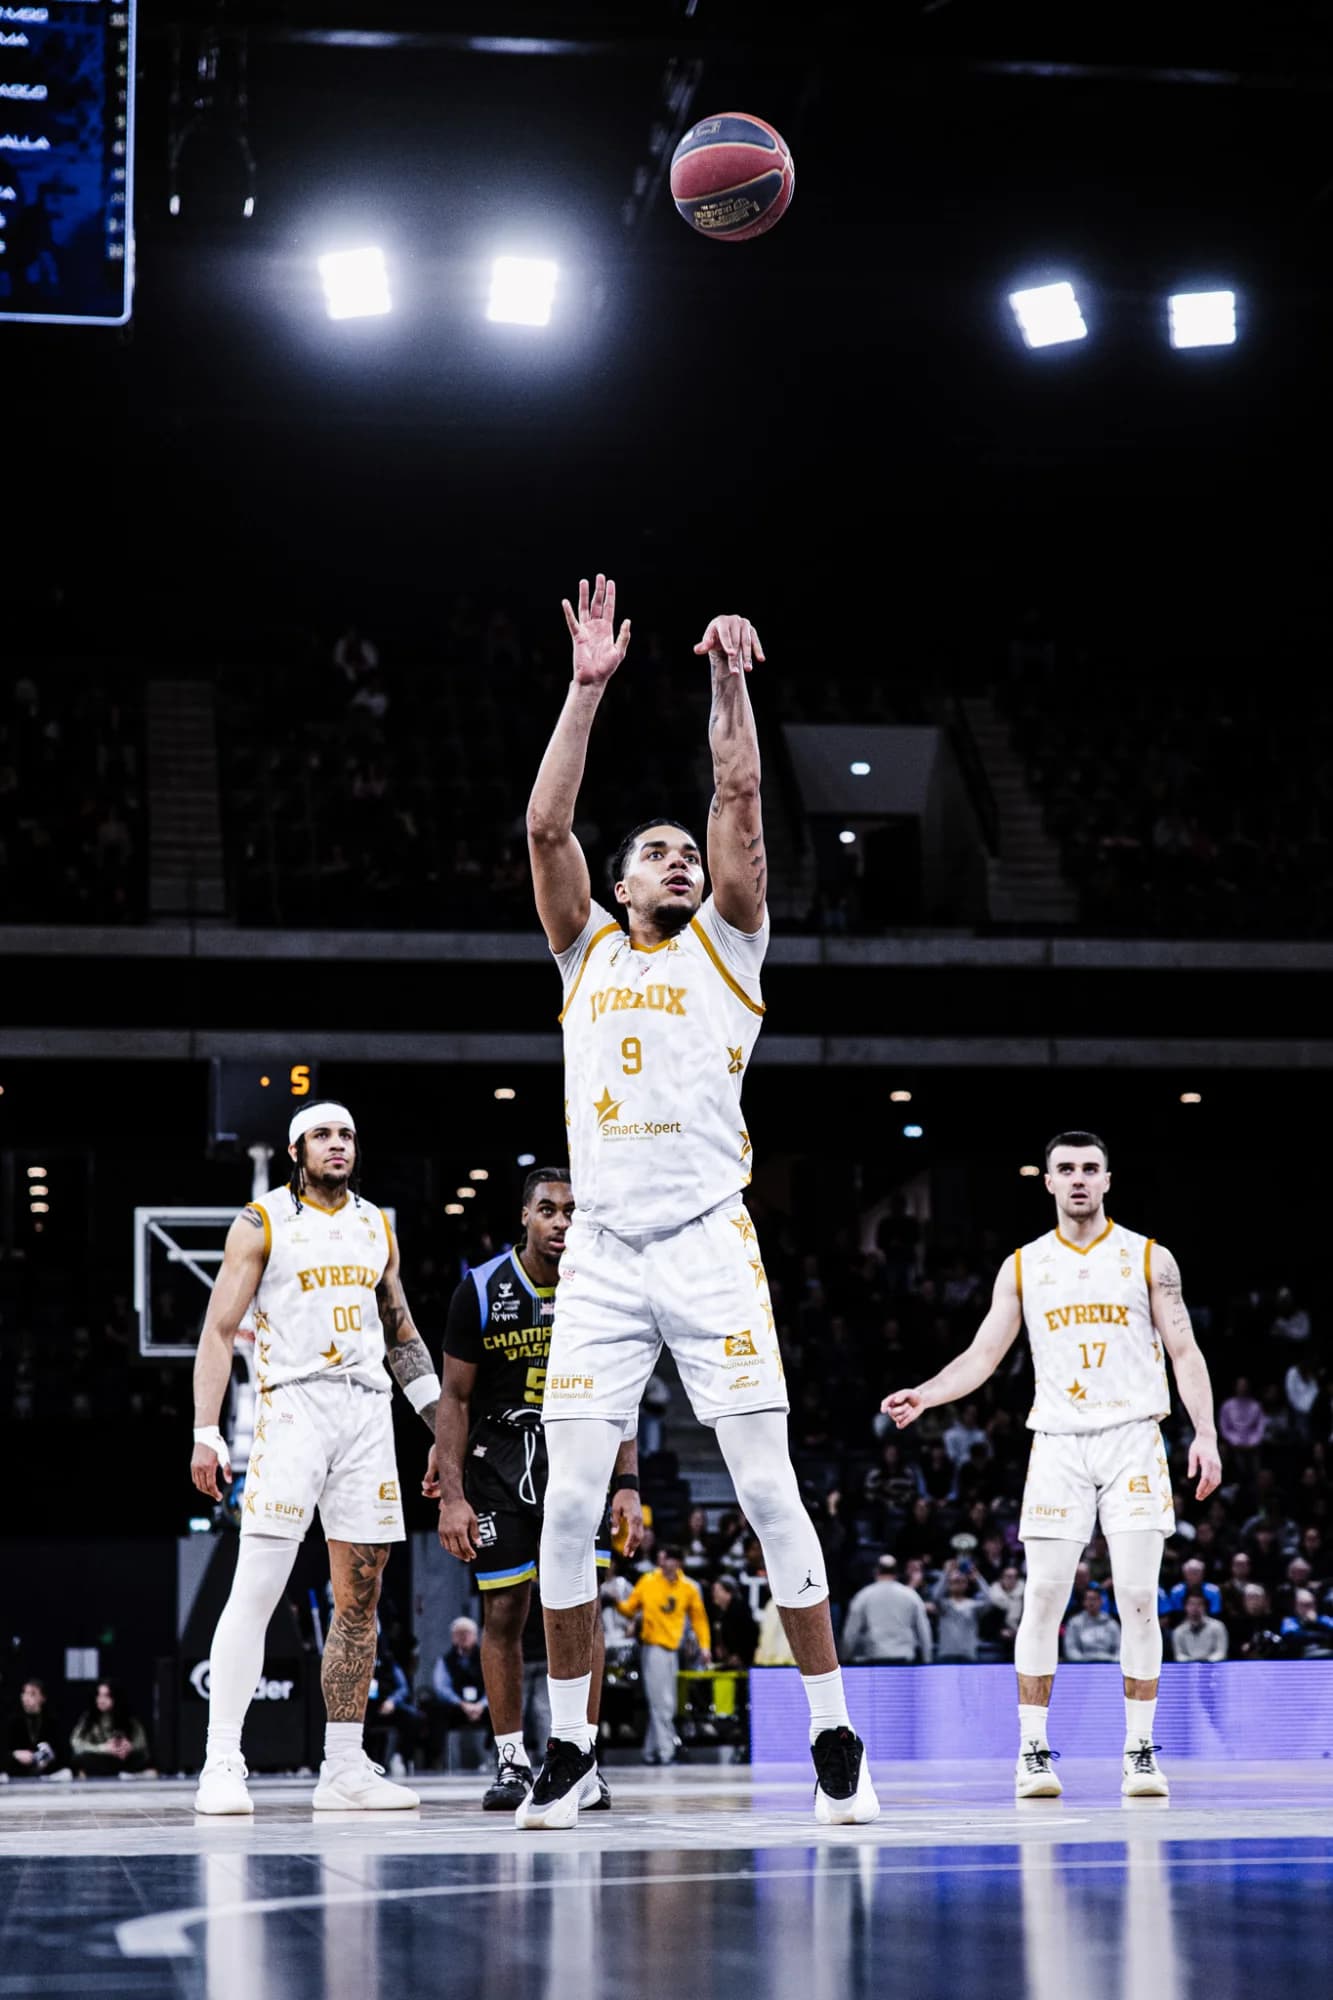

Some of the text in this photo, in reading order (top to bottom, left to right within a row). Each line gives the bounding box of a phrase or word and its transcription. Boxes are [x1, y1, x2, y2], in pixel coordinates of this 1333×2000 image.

[621, 1037, 642, 1075] 9
[602, 1122, 682, 1137] Smart-Xpert
[297, 1265, 379, 1292] EVREUX
[333, 1305, 361, 1333] 00
[1044, 1303, 1130, 1332] EVREUX
[483, 1326, 553, 1350] CHAMP
[504, 1342, 551, 1361] BAS
[1078, 1342, 1107, 1369] 17
[524, 1367, 547, 1404] 5
